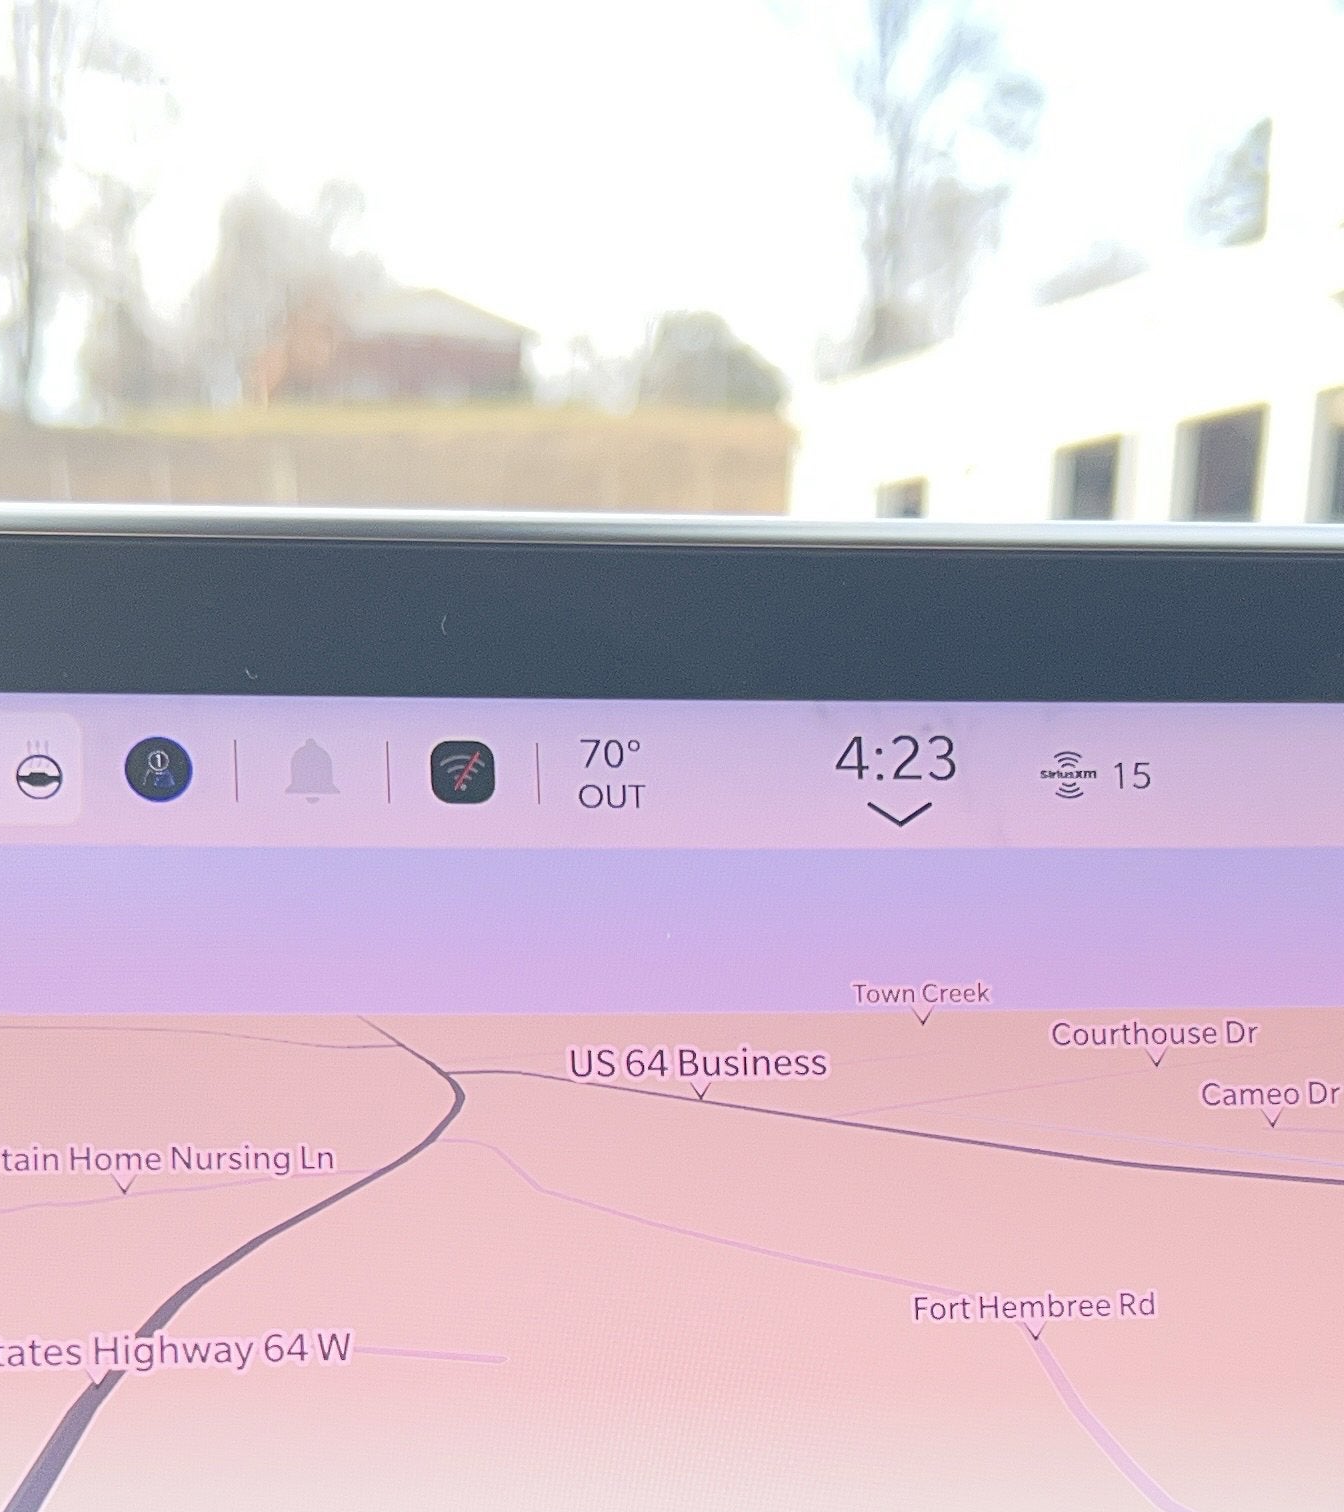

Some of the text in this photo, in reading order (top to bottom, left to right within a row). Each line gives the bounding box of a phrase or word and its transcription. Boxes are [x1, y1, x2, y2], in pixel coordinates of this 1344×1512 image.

[579, 738, 642, 770] 70°
[834, 734, 958, 783] 4:23
[1113, 762, 1152, 790] 15
[578, 784, 646, 810] OUT
[852, 981, 990, 1005] Town Creek
[1051, 1019, 1259, 1047] Courthouse Dr
[569, 1047, 828, 1079] US 64 Business
[1201, 1080, 1341, 1108] Cameo Dr
[69, 1145, 162, 1172] Home
[170, 1144, 292, 1176] Nursing
[300, 1145, 335, 1171] Ln
[913, 1291, 1156, 1321] Fort Hembree Rd
[93, 1333, 254, 1371] Highway
[264, 1333, 310, 1363] 64
[317, 1332, 352, 1362] W
